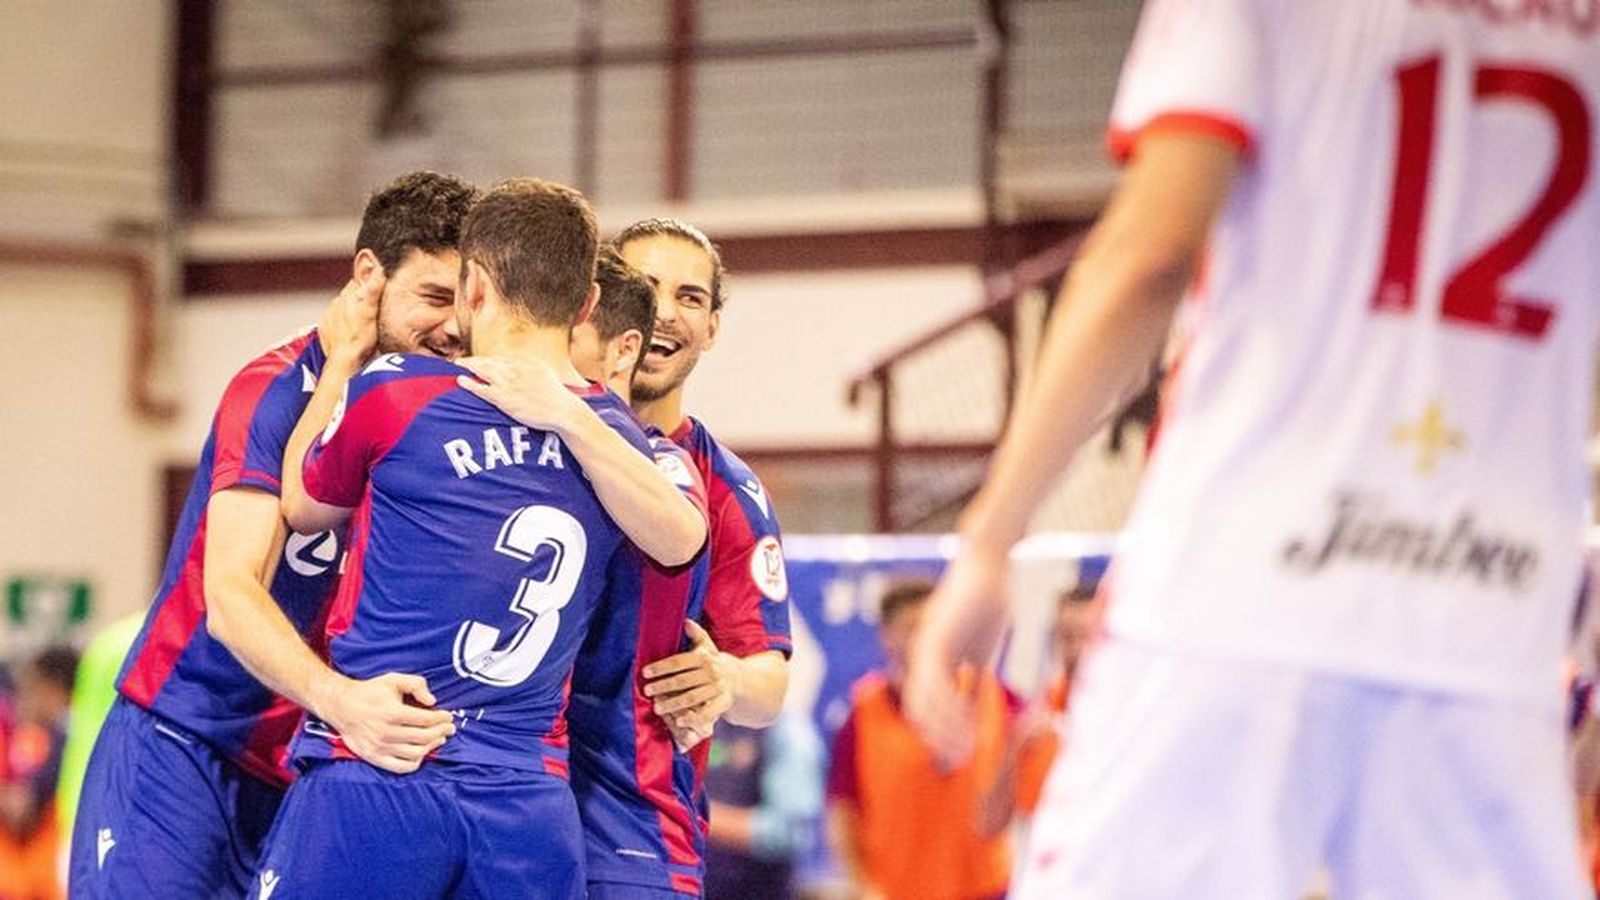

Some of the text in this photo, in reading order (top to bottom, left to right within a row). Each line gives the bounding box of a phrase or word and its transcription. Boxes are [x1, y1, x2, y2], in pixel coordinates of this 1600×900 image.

[1371, 52, 1591, 340] 12
[443, 426, 564, 479] RAFA
[452, 504, 587, 687] 3
